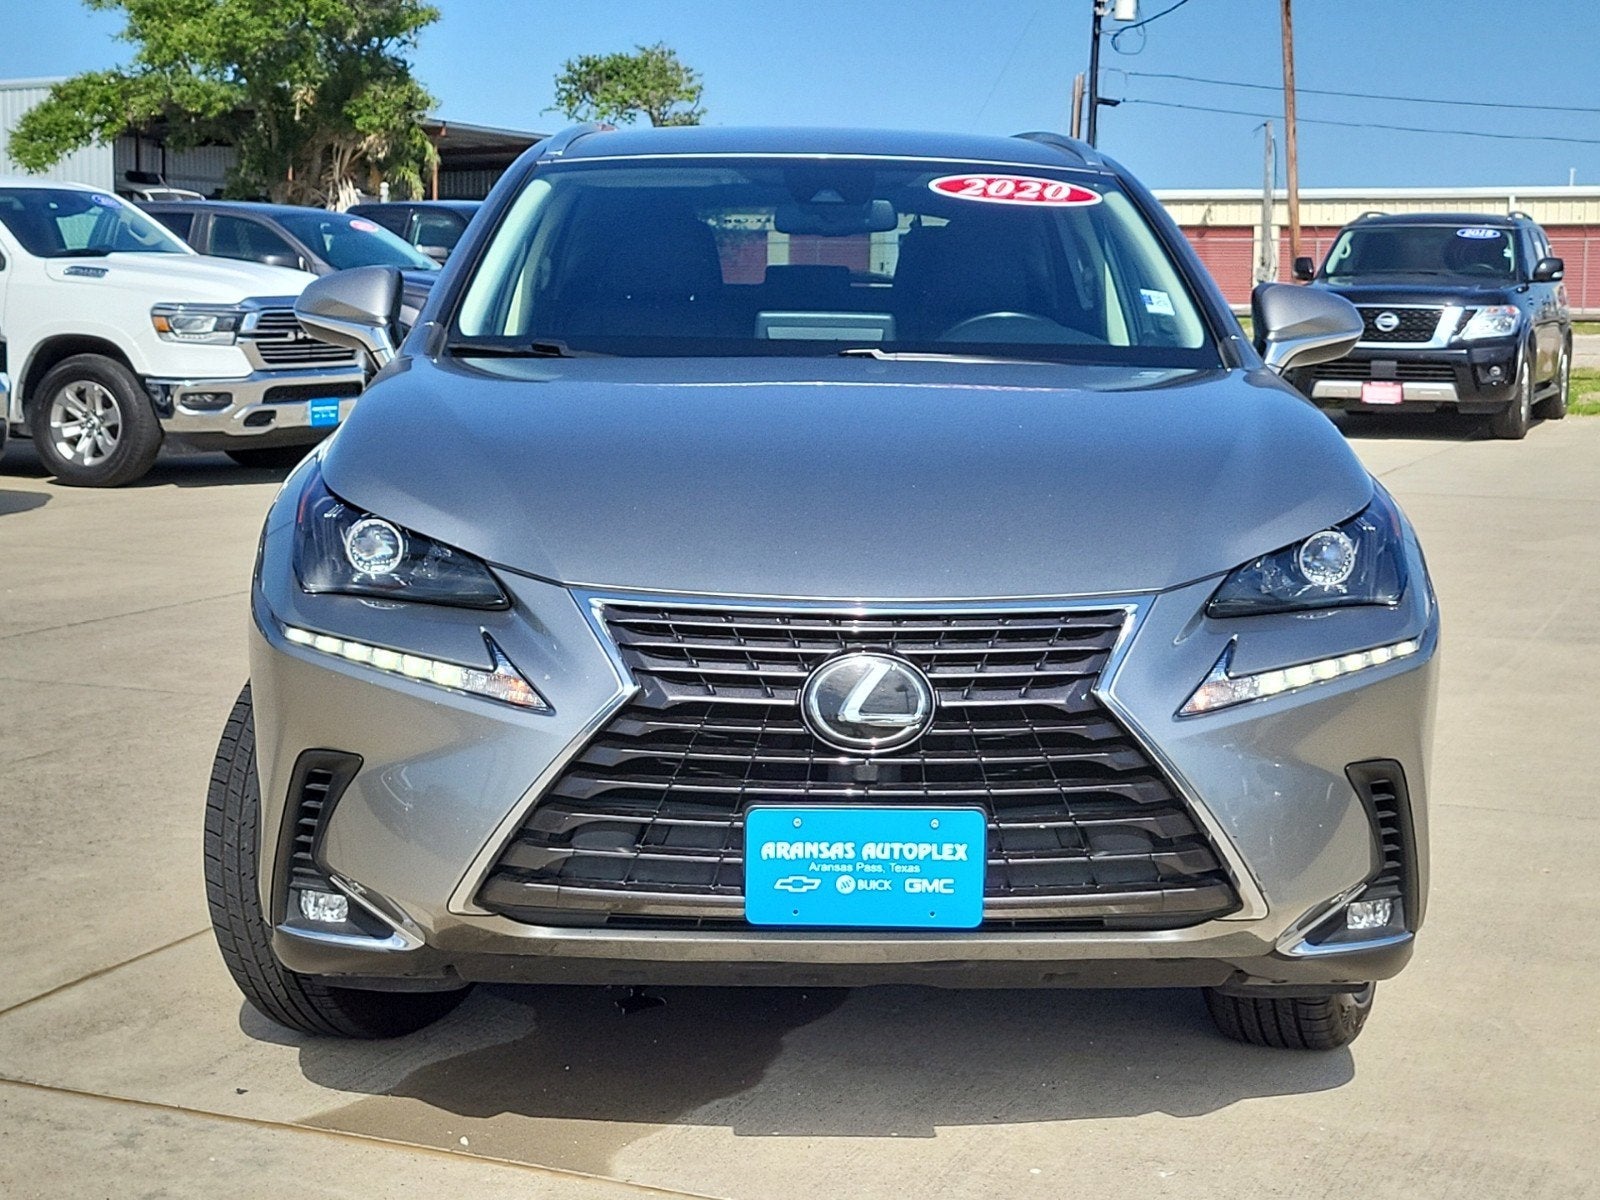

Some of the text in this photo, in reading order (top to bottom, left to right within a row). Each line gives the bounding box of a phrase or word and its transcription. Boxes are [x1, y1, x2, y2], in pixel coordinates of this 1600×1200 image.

[958, 178, 1071, 200] 2020
[761, 841, 969, 861] ARANSAS AUTOPLEX
[809, 861, 921, 873] Aransas Pass, Texas
[857, 879, 892, 891] BUICK
[904, 878, 955, 894] GMC
